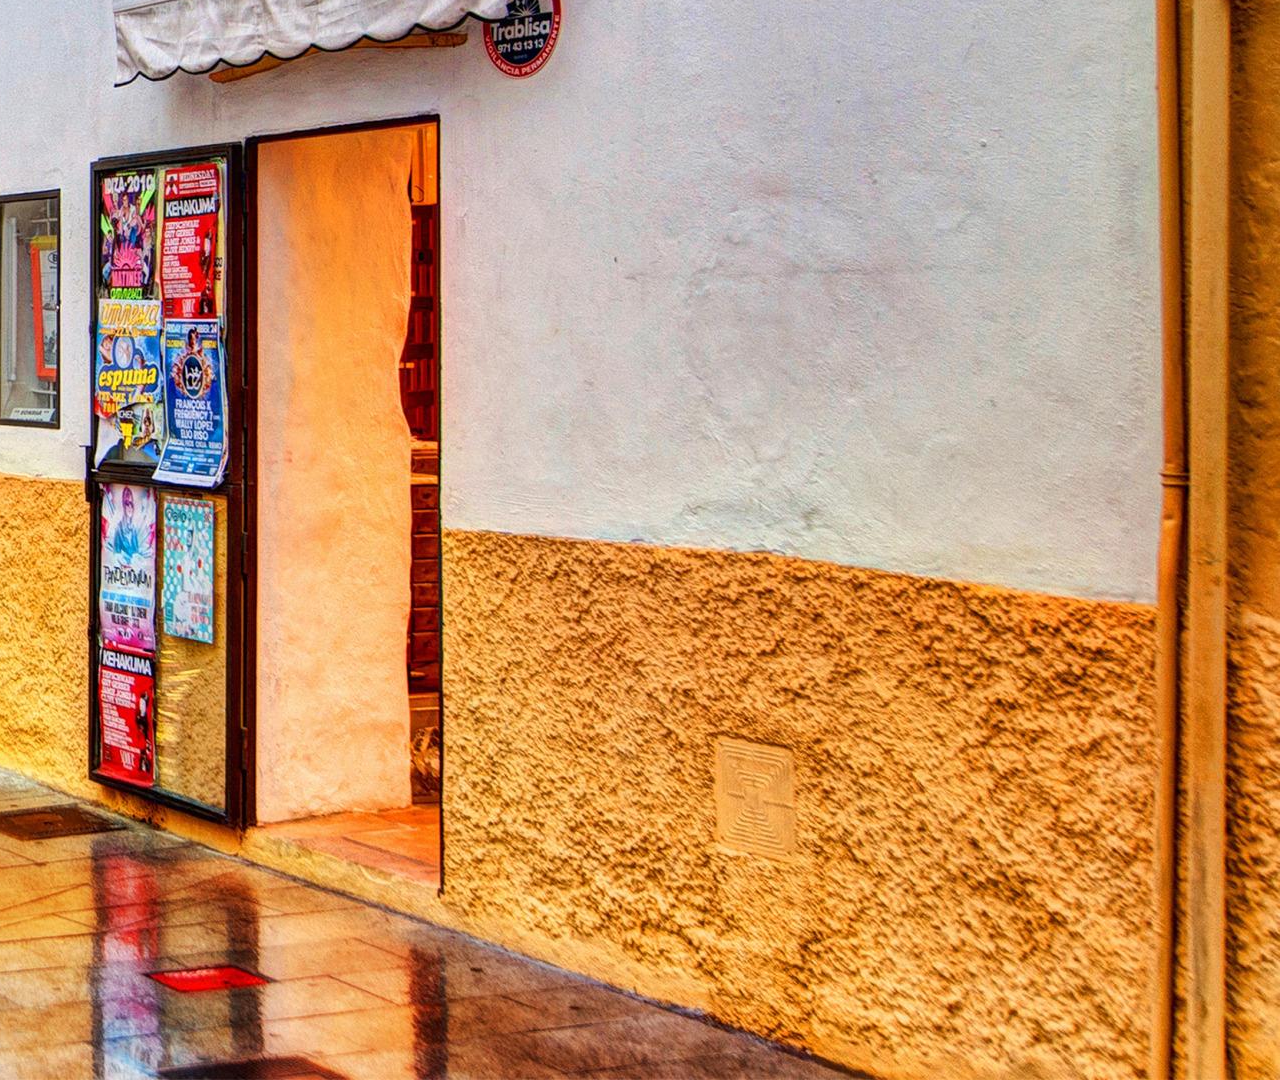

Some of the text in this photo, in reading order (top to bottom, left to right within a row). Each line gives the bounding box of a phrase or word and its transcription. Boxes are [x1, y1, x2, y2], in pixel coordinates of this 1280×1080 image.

[491, 16, 550, 41] Trablisa
[485, 15, 560, 75] VIGILANCIA PERMANENTE
[498, 39, 544, 53] 971 43 13 13
[165, 197, 216, 218] KEHAKUMA
[98, 367, 157, 391] espuma
[102, 650, 152, 676] KEHAKUMA
